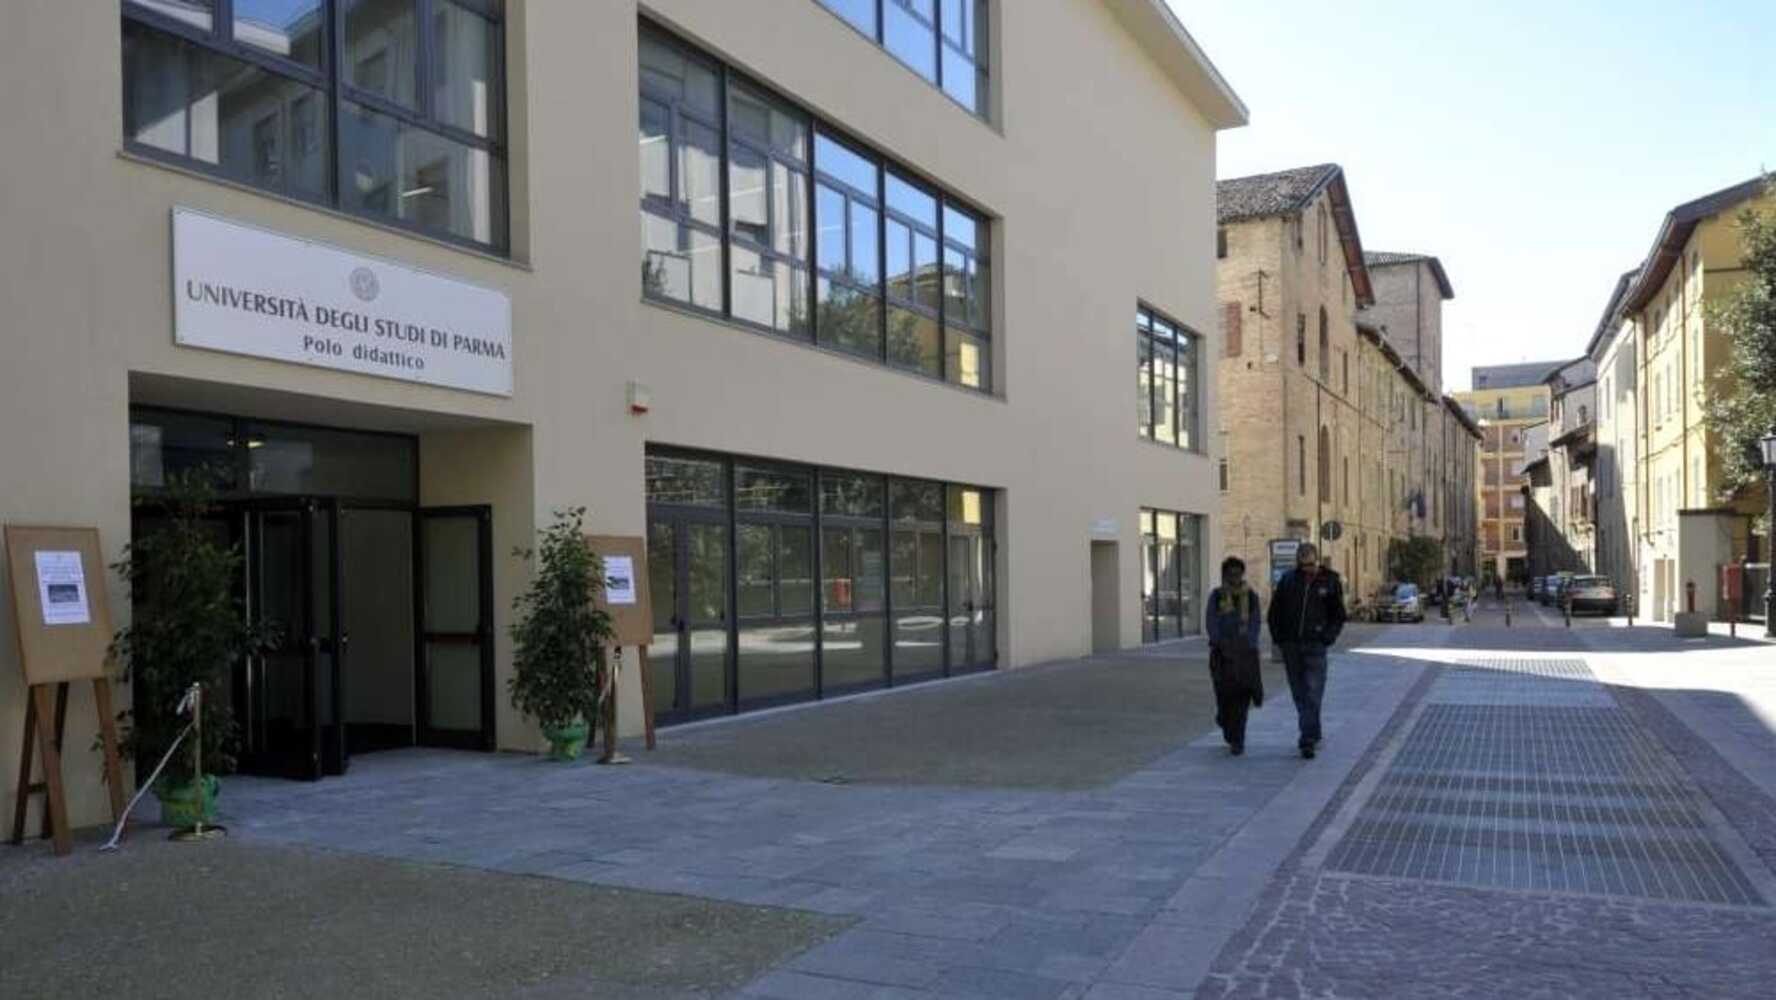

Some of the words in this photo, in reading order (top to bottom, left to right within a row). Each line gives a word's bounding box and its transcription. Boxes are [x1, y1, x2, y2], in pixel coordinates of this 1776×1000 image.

[187, 279, 309, 323] UNIVERSITÀ
[316, 306, 368, 333] DEGLI
[375, 318, 425, 345] STUDI
[430, 329, 448, 349] DI
[453, 334, 505, 360] PARMA
[304, 335, 342, 357] Polo
[352, 344, 425, 370] didattico
